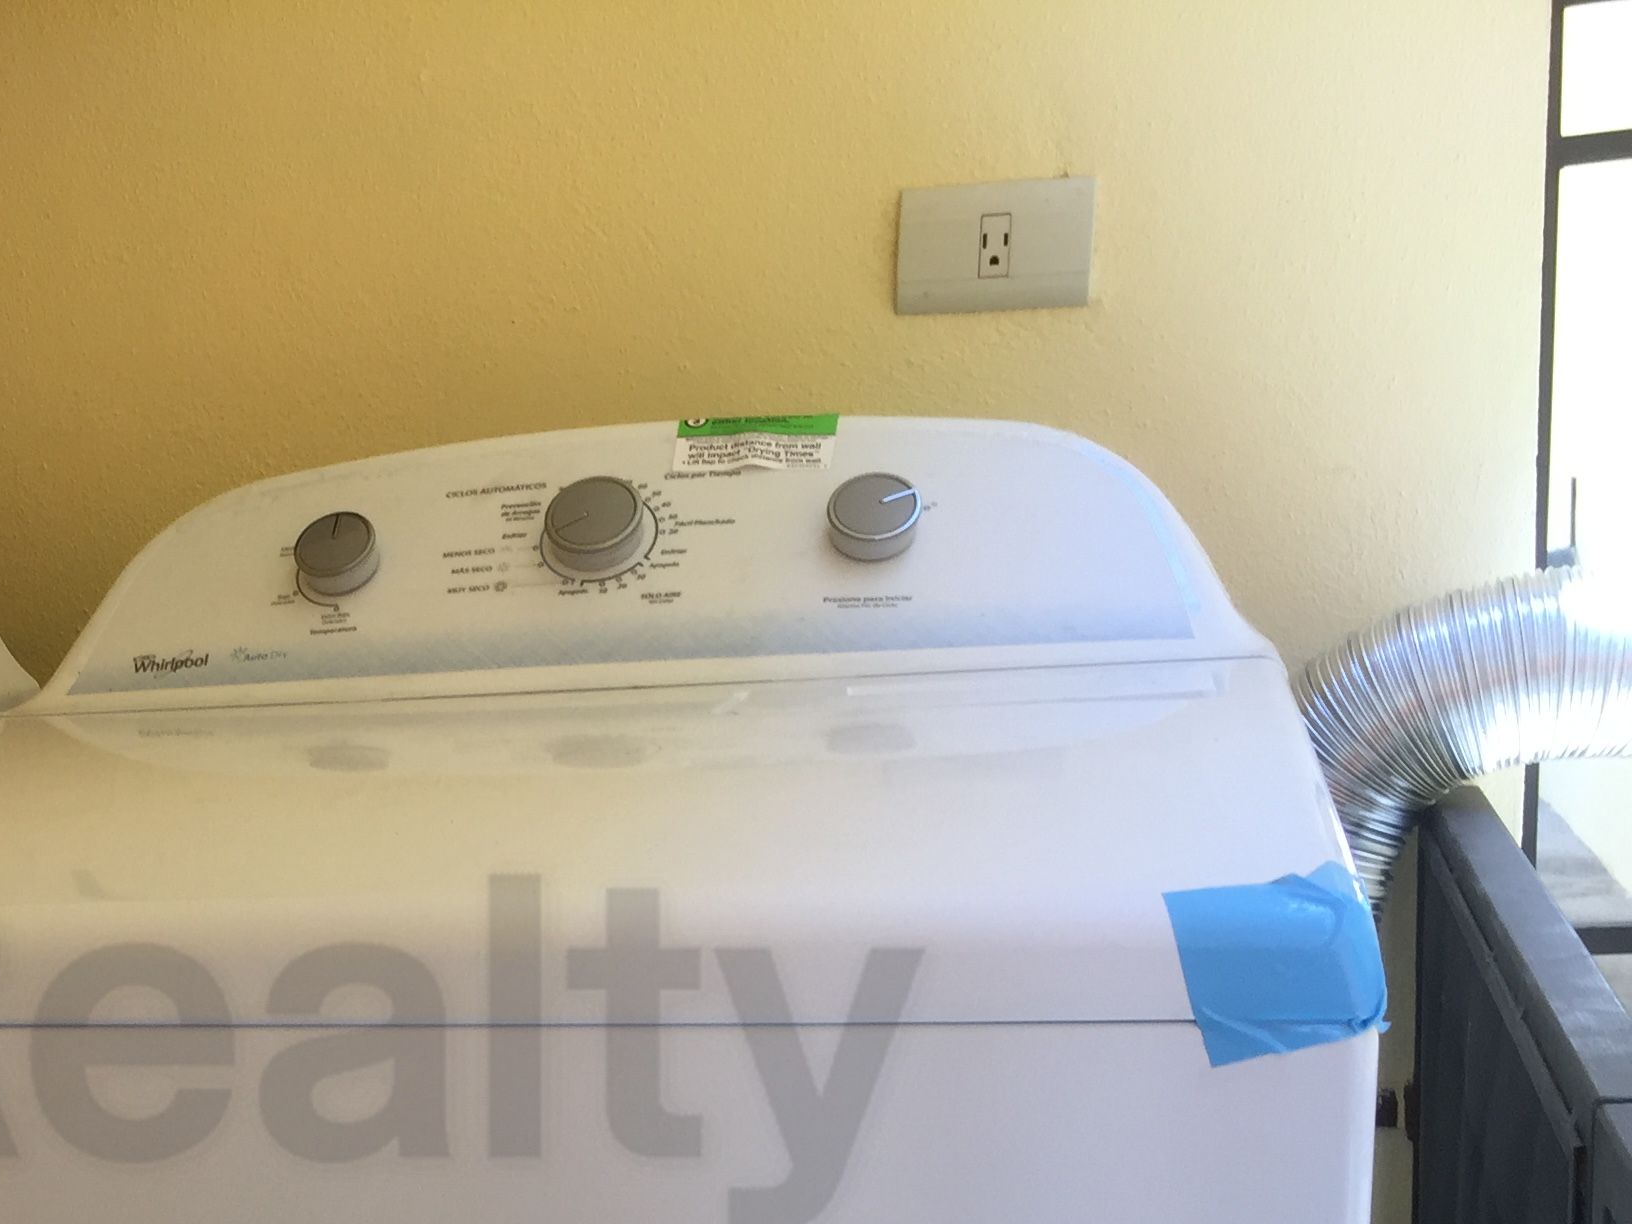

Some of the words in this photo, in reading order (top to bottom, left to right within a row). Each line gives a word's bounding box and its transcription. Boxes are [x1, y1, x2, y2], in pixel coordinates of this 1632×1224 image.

[688, 442, 728, 452] Product
[731, 439, 773, 449] distance
[775, 441, 799, 449] from
[688, 451, 705, 459] will
[707, 450, 741, 459] impact
[445, 488, 478, 498] CICLOS
[480, 482, 548, 494] AUTOMÁTICOS
[473, 547, 496, 556] SECO
[471, 565, 493, 573] SECO
[132, 652, 210, 674] Whirlpool
[243, 651, 268, 663] Auto
